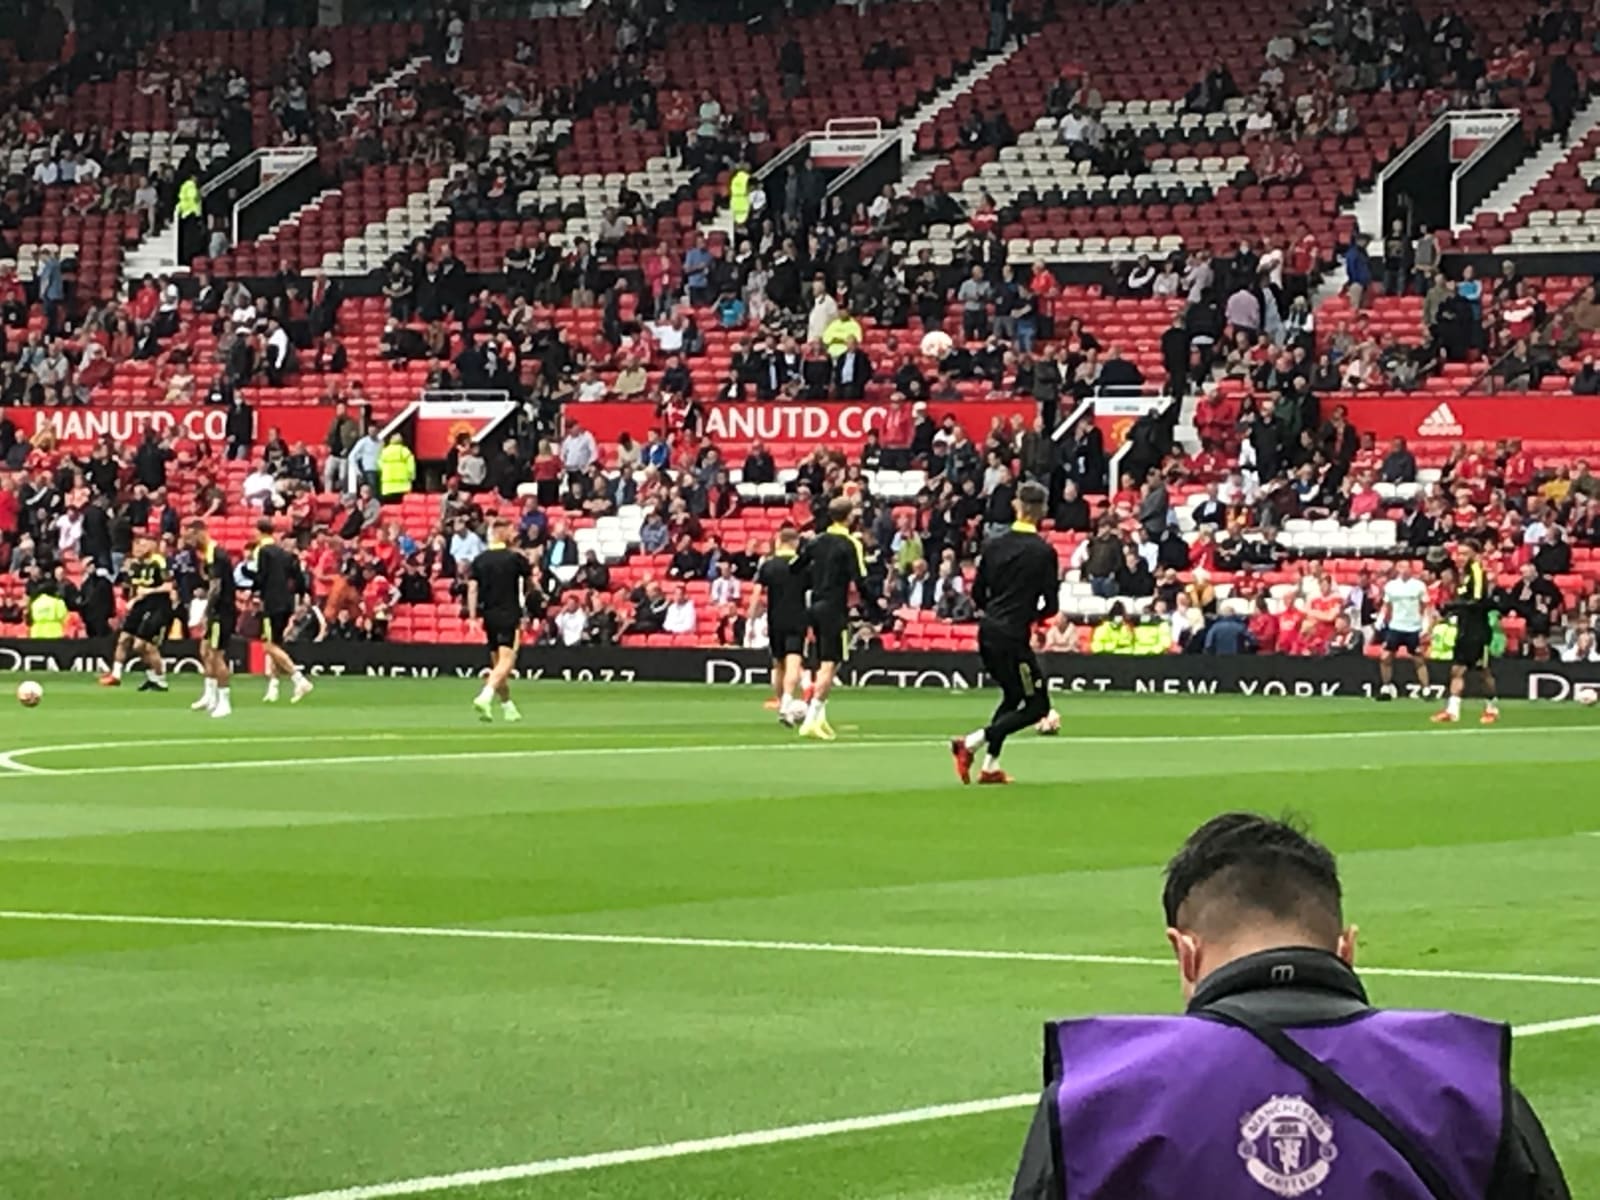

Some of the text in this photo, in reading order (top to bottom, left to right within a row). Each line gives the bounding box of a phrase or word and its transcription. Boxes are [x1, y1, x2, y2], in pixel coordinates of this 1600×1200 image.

[35, 410, 258, 441] MANUTDCO
[696, 406, 887, 438] ANUTD.CO
[1247, 1101, 1326, 1136] MANCHESTER
[1262, 1172, 1318, 1188] UNITED
